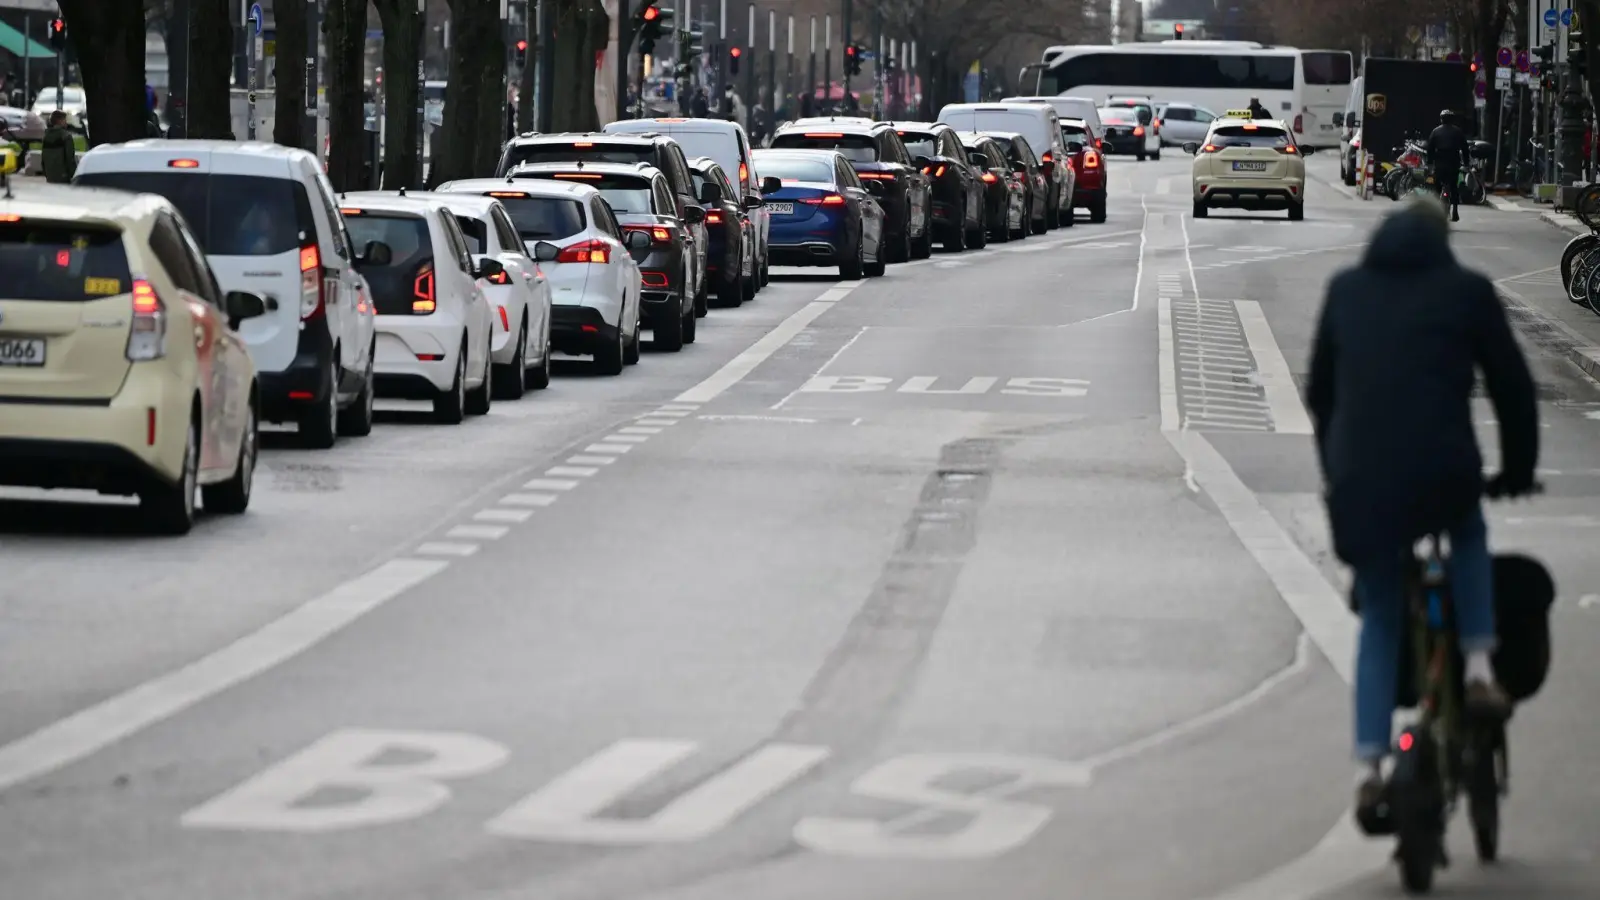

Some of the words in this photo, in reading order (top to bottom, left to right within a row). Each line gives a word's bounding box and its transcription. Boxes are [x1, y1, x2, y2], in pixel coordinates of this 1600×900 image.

[775, 203, 793, 212] 2907
[0, 340, 36, 359] 066
[800, 376, 1091, 396] BUS
[180, 728, 1093, 859] BUS
